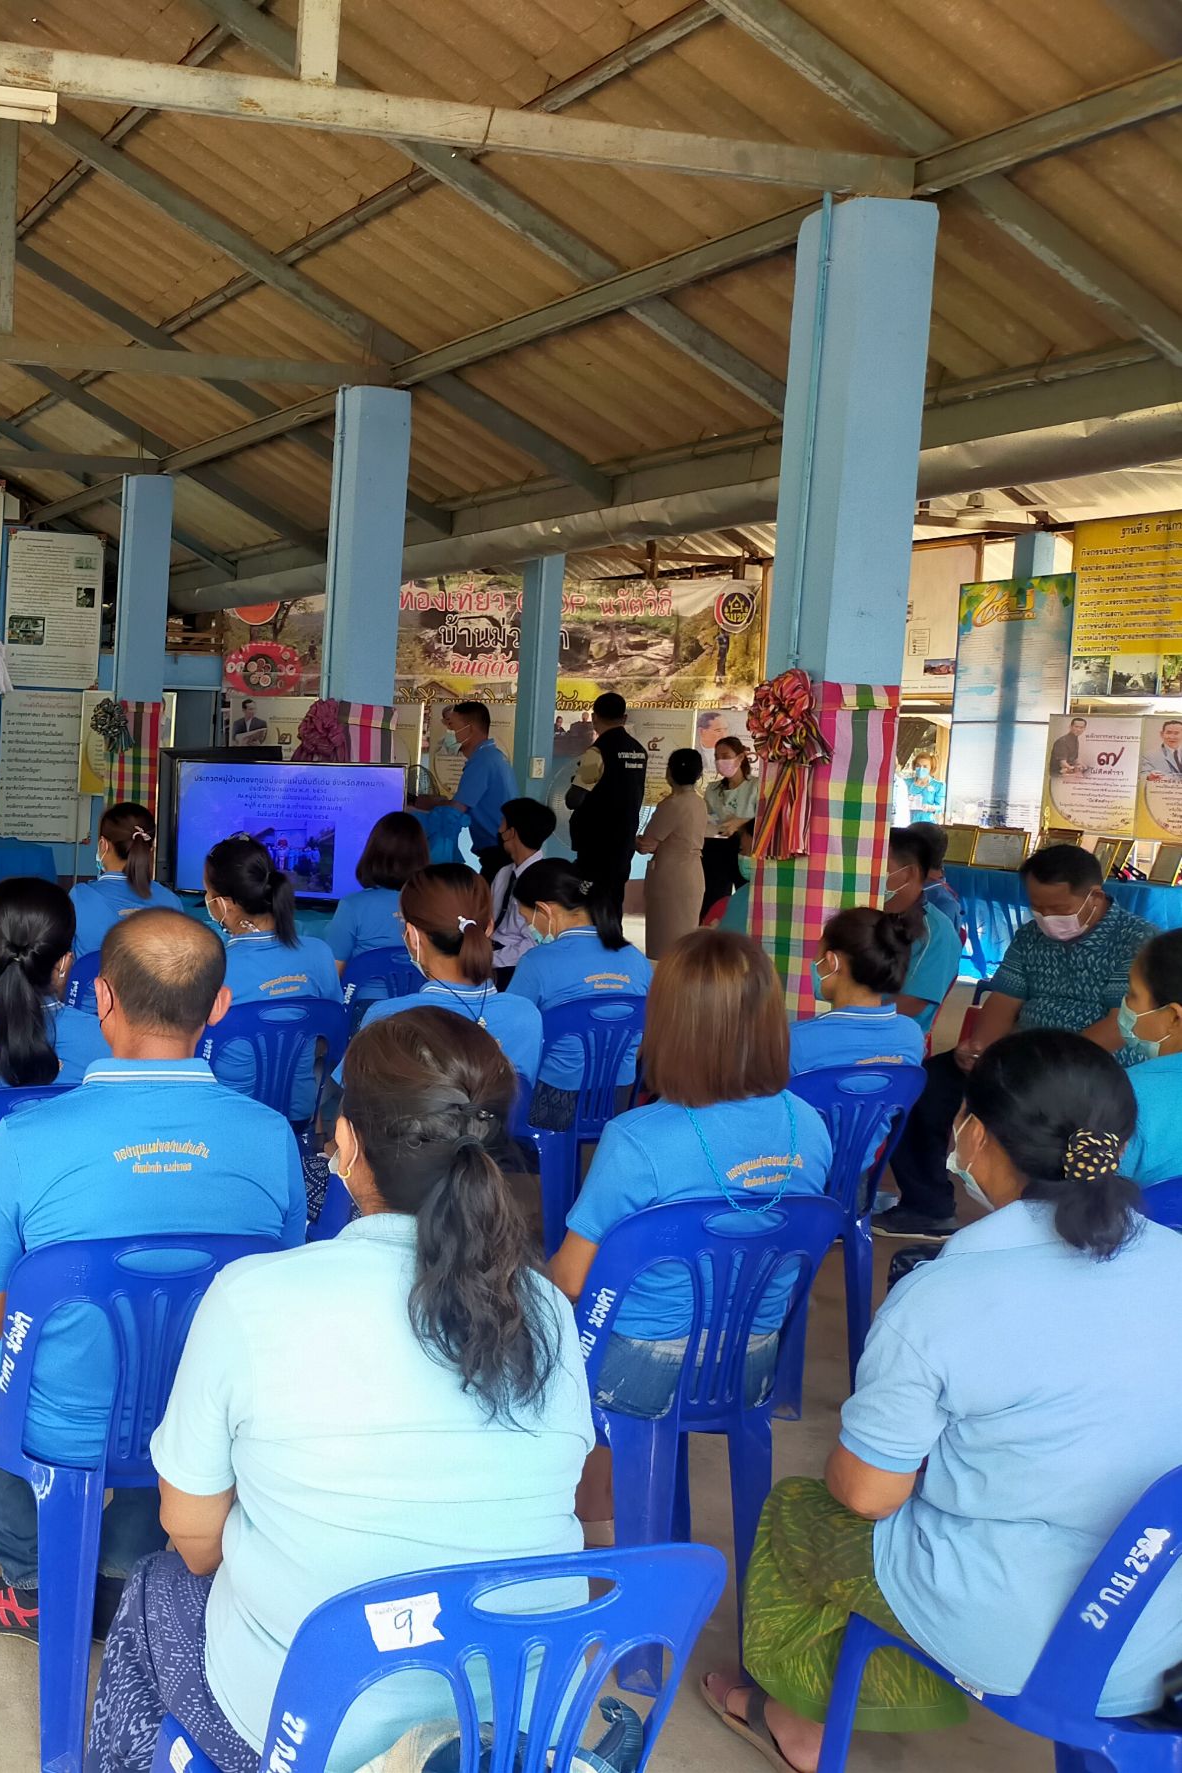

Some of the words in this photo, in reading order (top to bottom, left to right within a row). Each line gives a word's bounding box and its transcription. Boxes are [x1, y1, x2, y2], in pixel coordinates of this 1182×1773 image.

[1120, 521, 1144, 538] ฐานที่
[1144, 525, 1151, 533] 5
[599, 587, 674, 618] นวัตวิถี
[1097, 746, 1125, 767] ๗
[579, 1330, 597, 1362] ทบ
[393, 1609, 414, 1644] 9
[1080, 1602, 1109, 1630] 27
